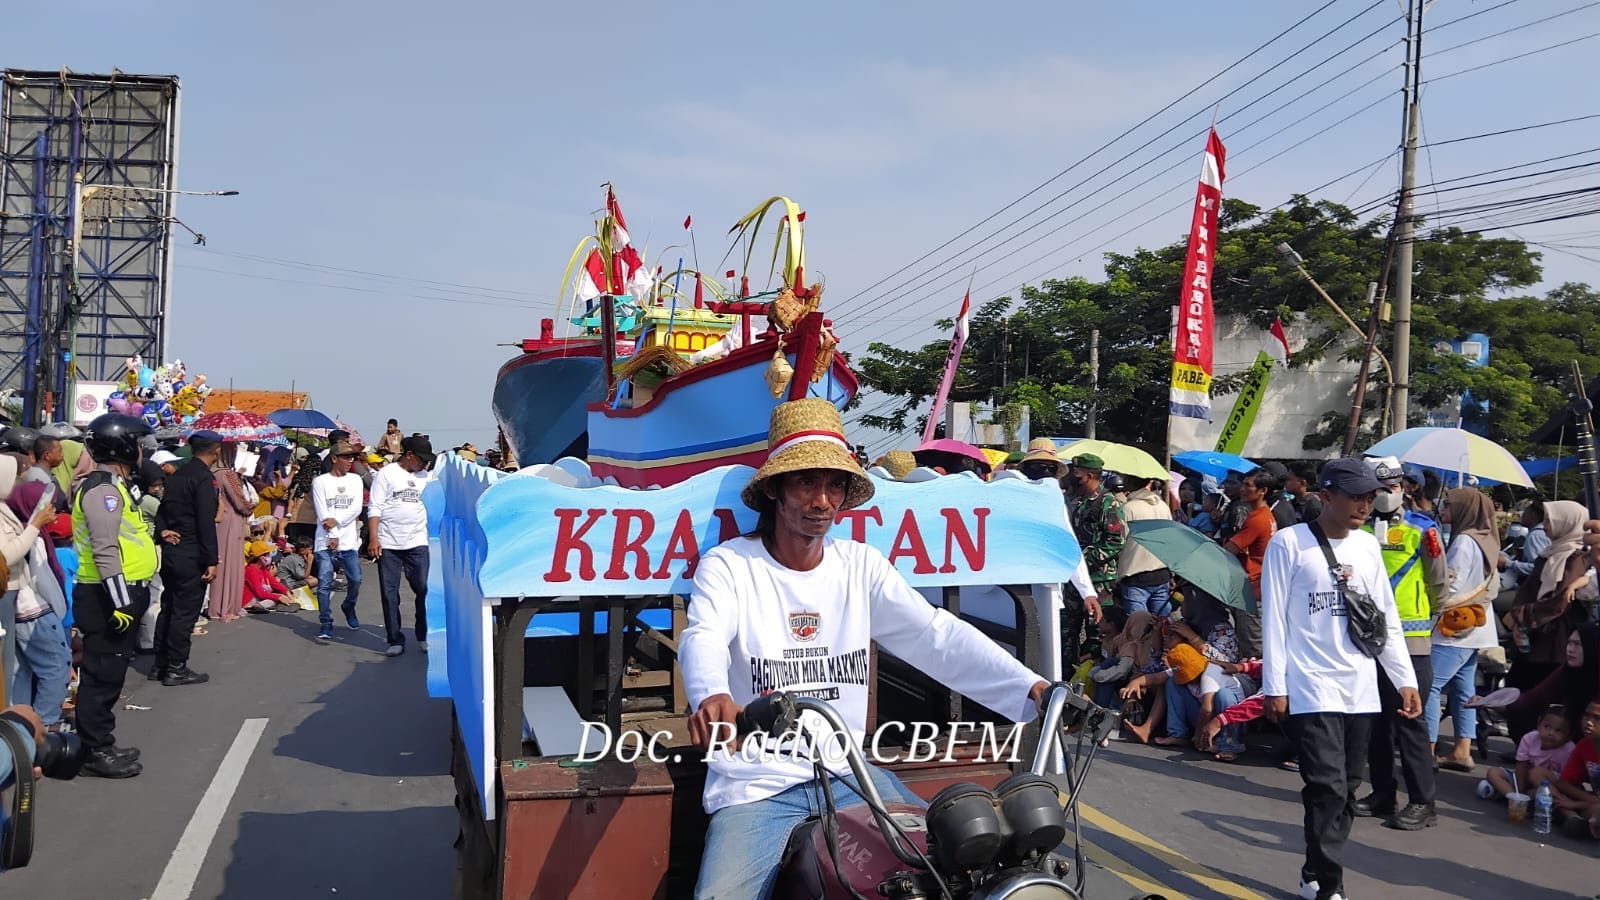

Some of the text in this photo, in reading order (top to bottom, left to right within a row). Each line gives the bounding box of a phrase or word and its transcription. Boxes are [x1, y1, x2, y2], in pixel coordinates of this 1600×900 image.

[1176, 368, 1206, 386] PABE
[543, 507, 991, 583] KRATAN
[783, 646, 829, 659] GUYUB RUKUN
[750, 657, 800, 694] PAGUYUBAN
[801, 659, 827, 683] MINA
[793, 688, 830, 700] RAMATAN
